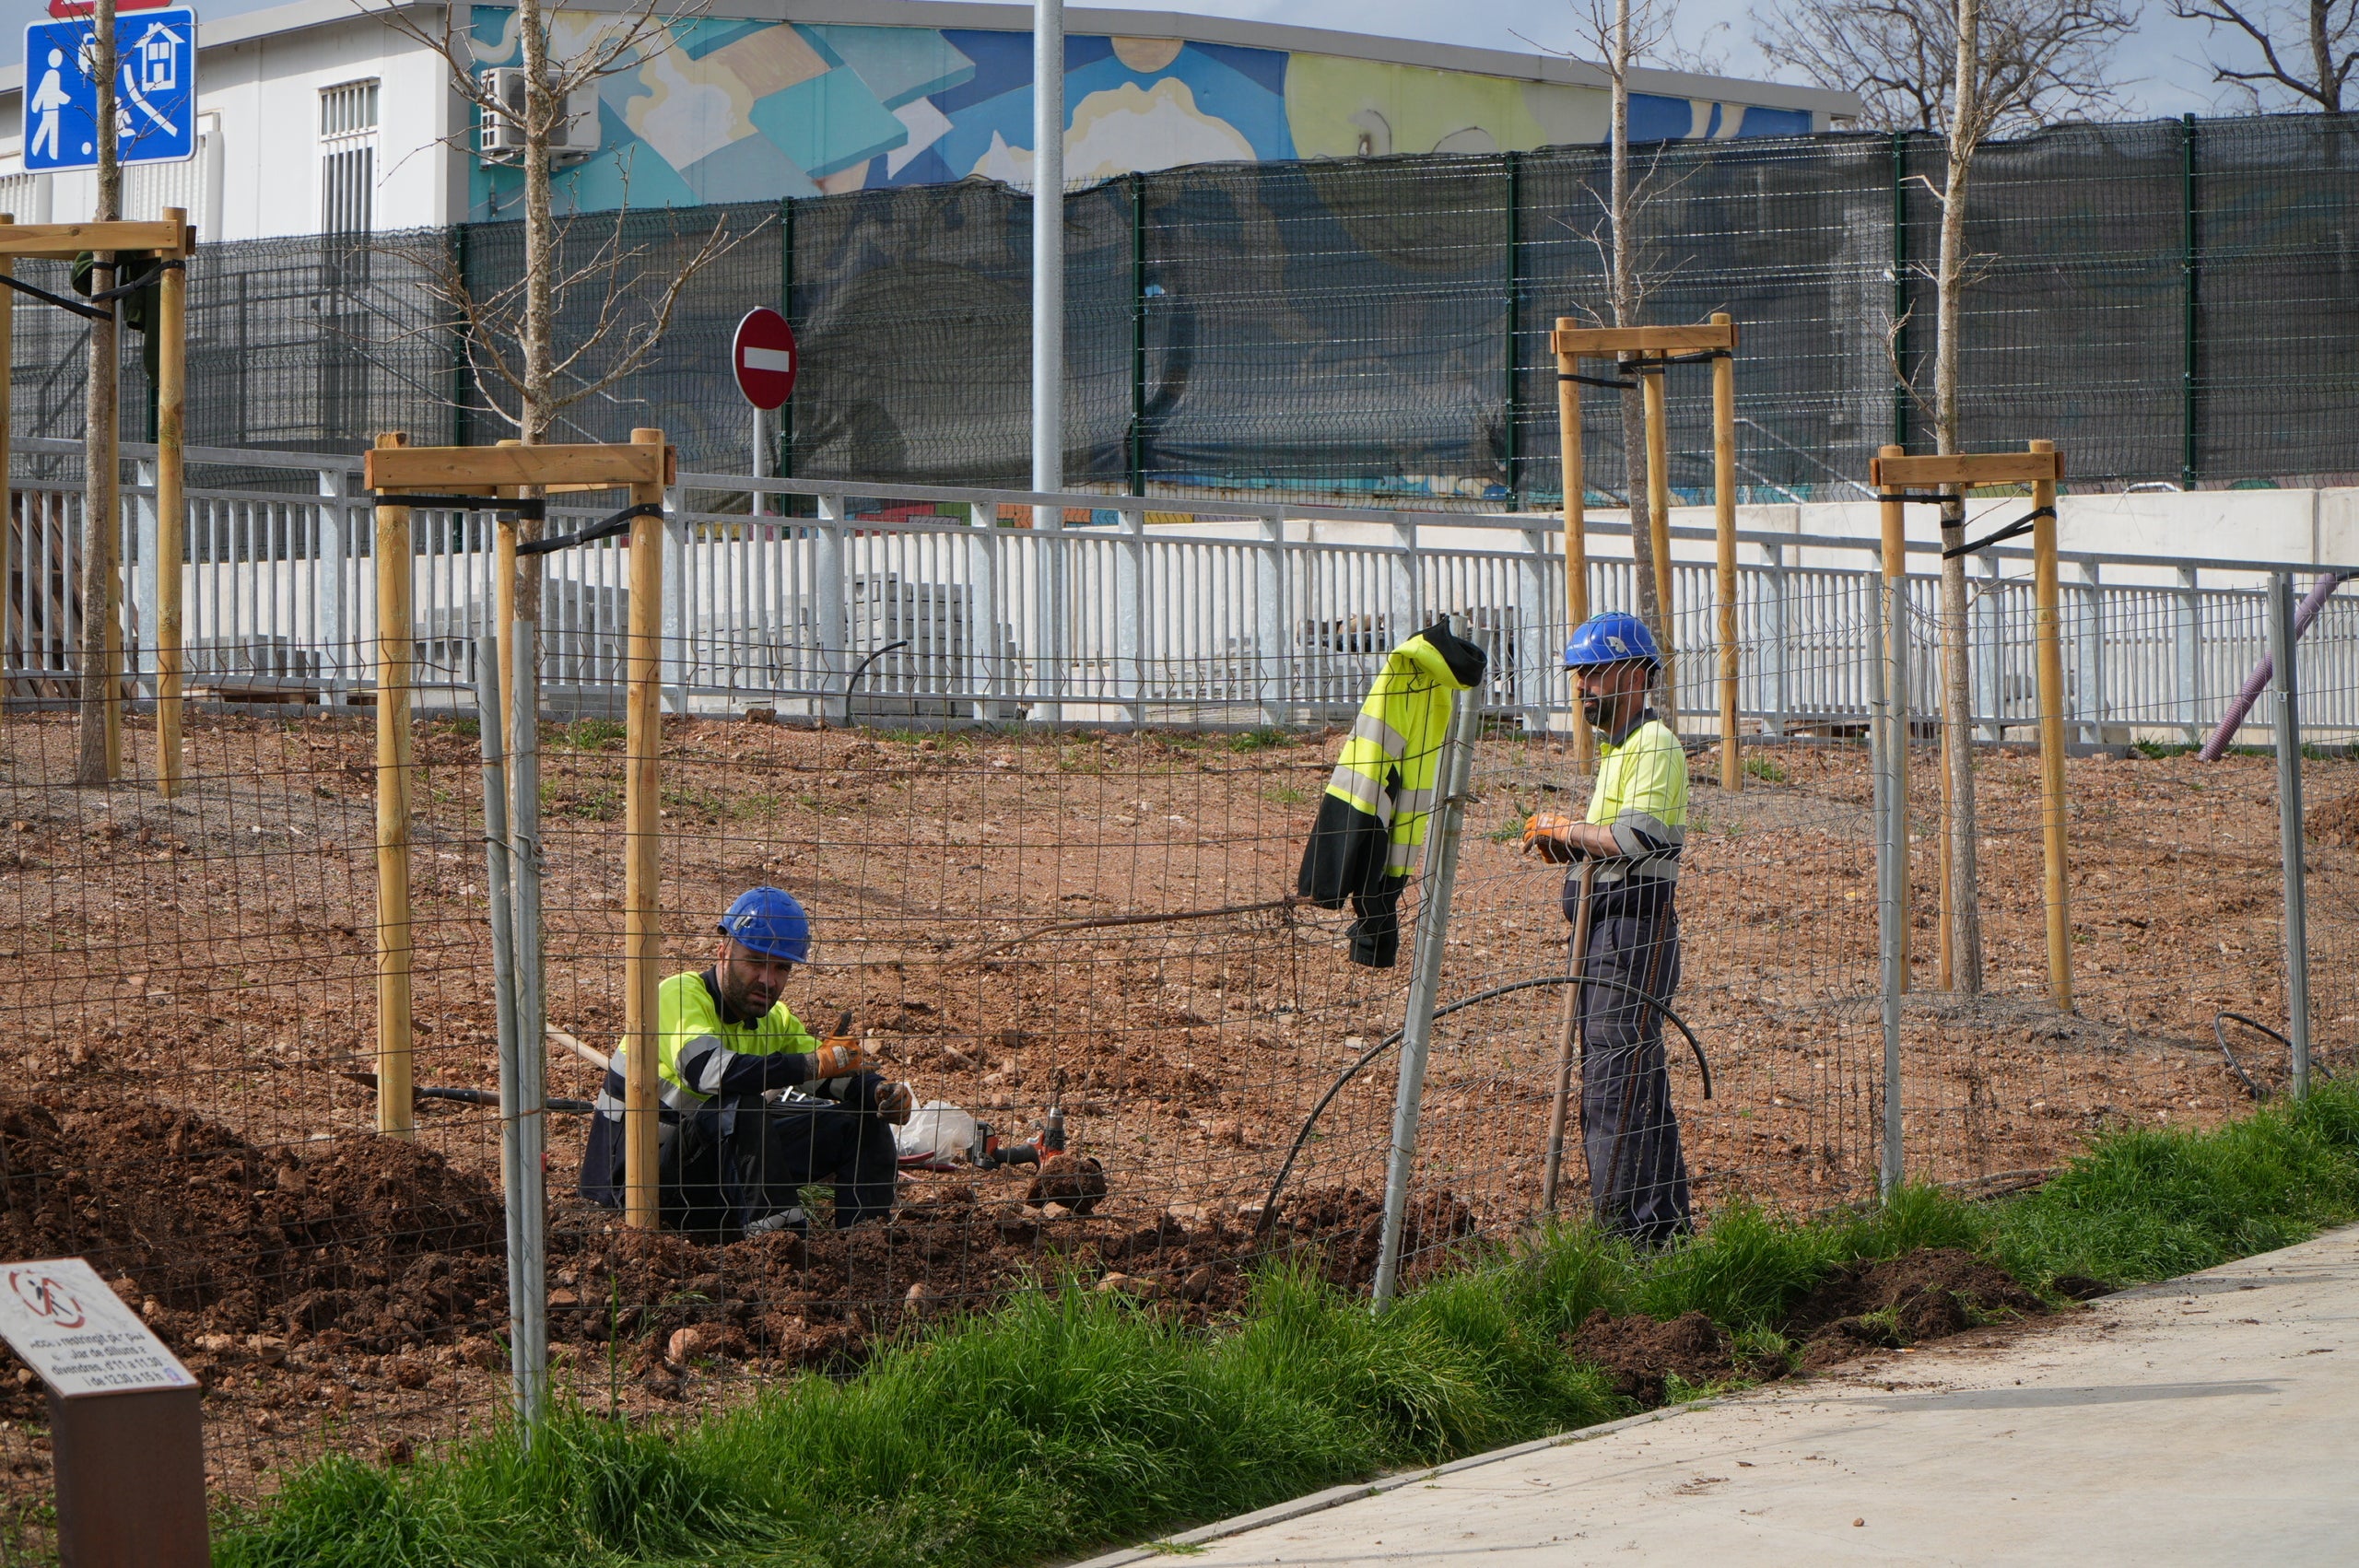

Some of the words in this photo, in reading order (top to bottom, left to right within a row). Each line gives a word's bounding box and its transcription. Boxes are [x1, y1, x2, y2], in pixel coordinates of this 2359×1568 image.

[60, 1333, 108, 1346] restringit
[108, 1333, 122, 1343] pe
[89, 1348, 104, 1357] de
[104, 1346, 139, 1356] dilluns
[105, 1359, 127, 1370] d'11
[127, 1361, 136, 1369] a
[135, 1356, 163, 1368] 11.30
[90, 1376, 106, 1387] de
[104, 1373, 133, 1385] 12.30
[133, 1374, 142, 1383] a
[140, 1372, 155, 1382] 15
[152, 1370, 164, 1381] h
